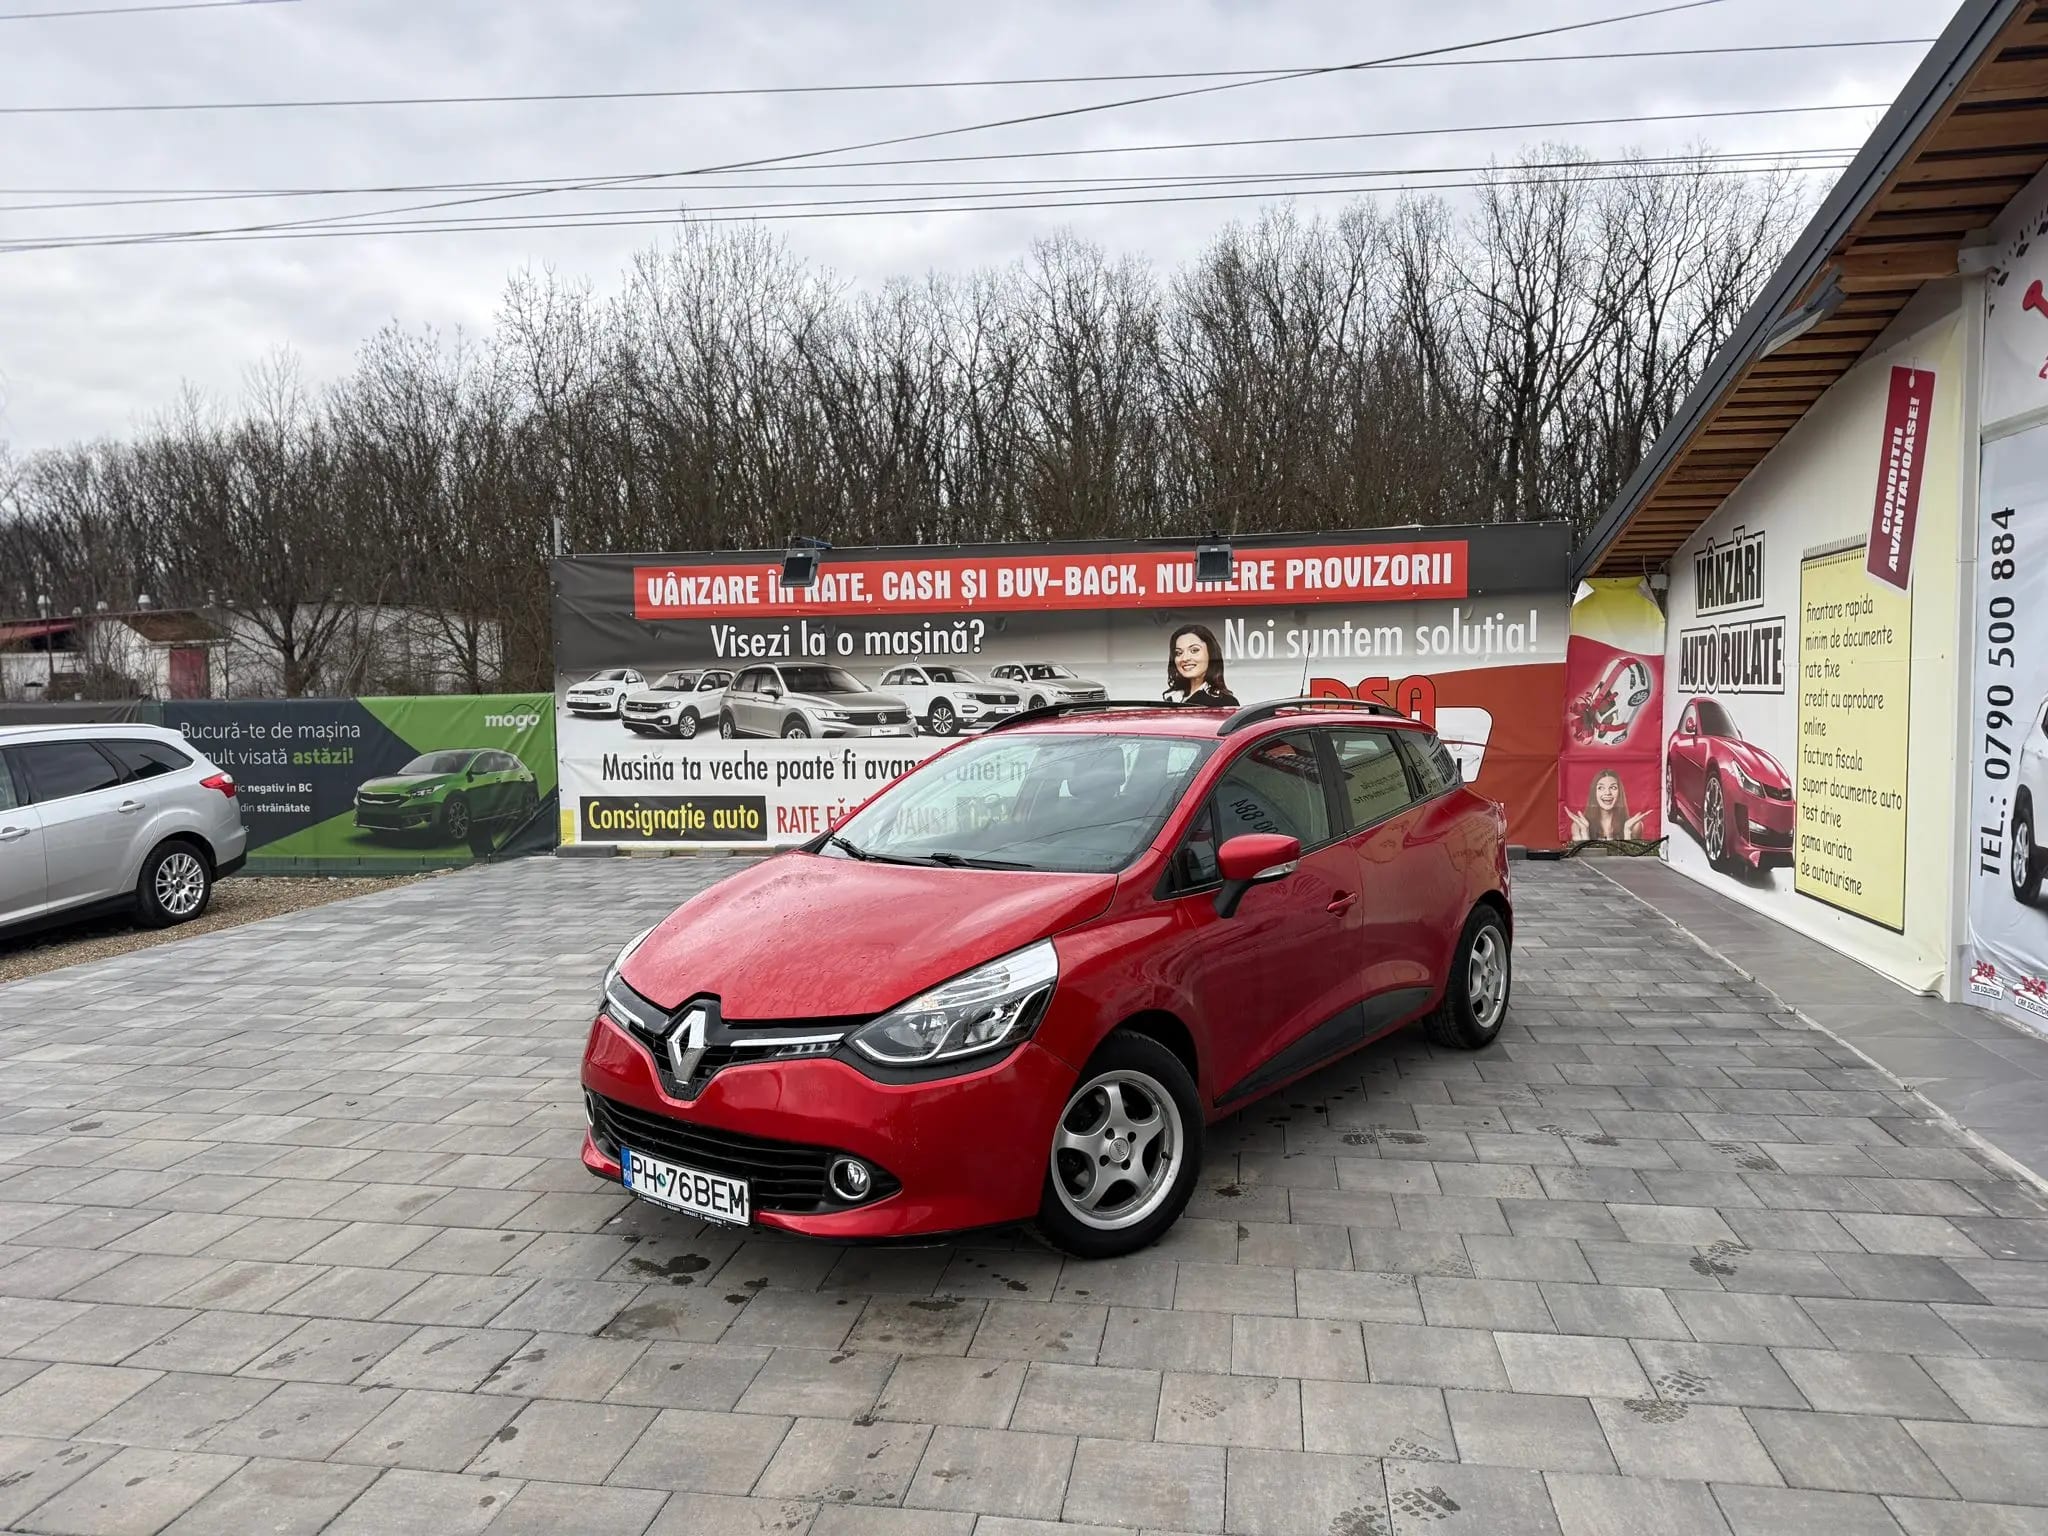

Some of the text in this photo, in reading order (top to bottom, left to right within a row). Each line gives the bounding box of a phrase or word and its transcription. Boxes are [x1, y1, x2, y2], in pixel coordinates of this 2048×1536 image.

[1888, 397, 1920, 573] AVANTAJOASE!
[648, 572, 759, 606] VÂNZARE
[804, 573, 873, 604] RATE,
[883, 570, 951, 601] CASH
[961, 569, 987, 605] ȘI
[998, 565, 1146, 597] BUY-BACK,
[1286, 553, 1452, 590] PROVIZORII
[1697, 536, 1762, 610] VÂNZĂRI
[1845, 593, 1873, 622] rapida
[710, 618, 985, 662] Visezi la o mașină?
[1224, 607, 1538, 660] Noi suntem solutia!
[1805, 625, 1893, 651] minim de documente
[1680, 626, 1783, 686] AUTO RULATE
[1805, 658, 1841, 679] rate fixe
[1804, 688, 1884, 716] credit cu aprobare
[1980, 506, 2016, 876] TEL.: 0790 500 884
[180, 721, 361, 742] Bucură-te de mașina
[484, 714, 540, 733] mogo
[1803, 716, 1827, 736] online
[239, 748, 288, 765] visată
[293, 747, 354, 765] astăzi!
[682, 756, 701, 781] ta
[709, 750, 769, 781] veche
[776, 755, 835, 787] poate
[842, 749, 857, 780] fi
[1803, 743, 1863, 771] factura fiscala
[248, 783, 285, 795] negativ
[298, 783, 313, 793] BC
[1802, 776, 1903, 810] suport documente auto
[256, 803, 311, 813] străinătate
[588, 801, 705, 838] Consignație
[713, 804, 760, 830] auto
[777, 805, 821, 834] RATE
[1802, 802, 1842, 828] test drive
[1801, 833, 1853, 862] gama variata
[1800, 855, 1863, 896] de autoturisme
